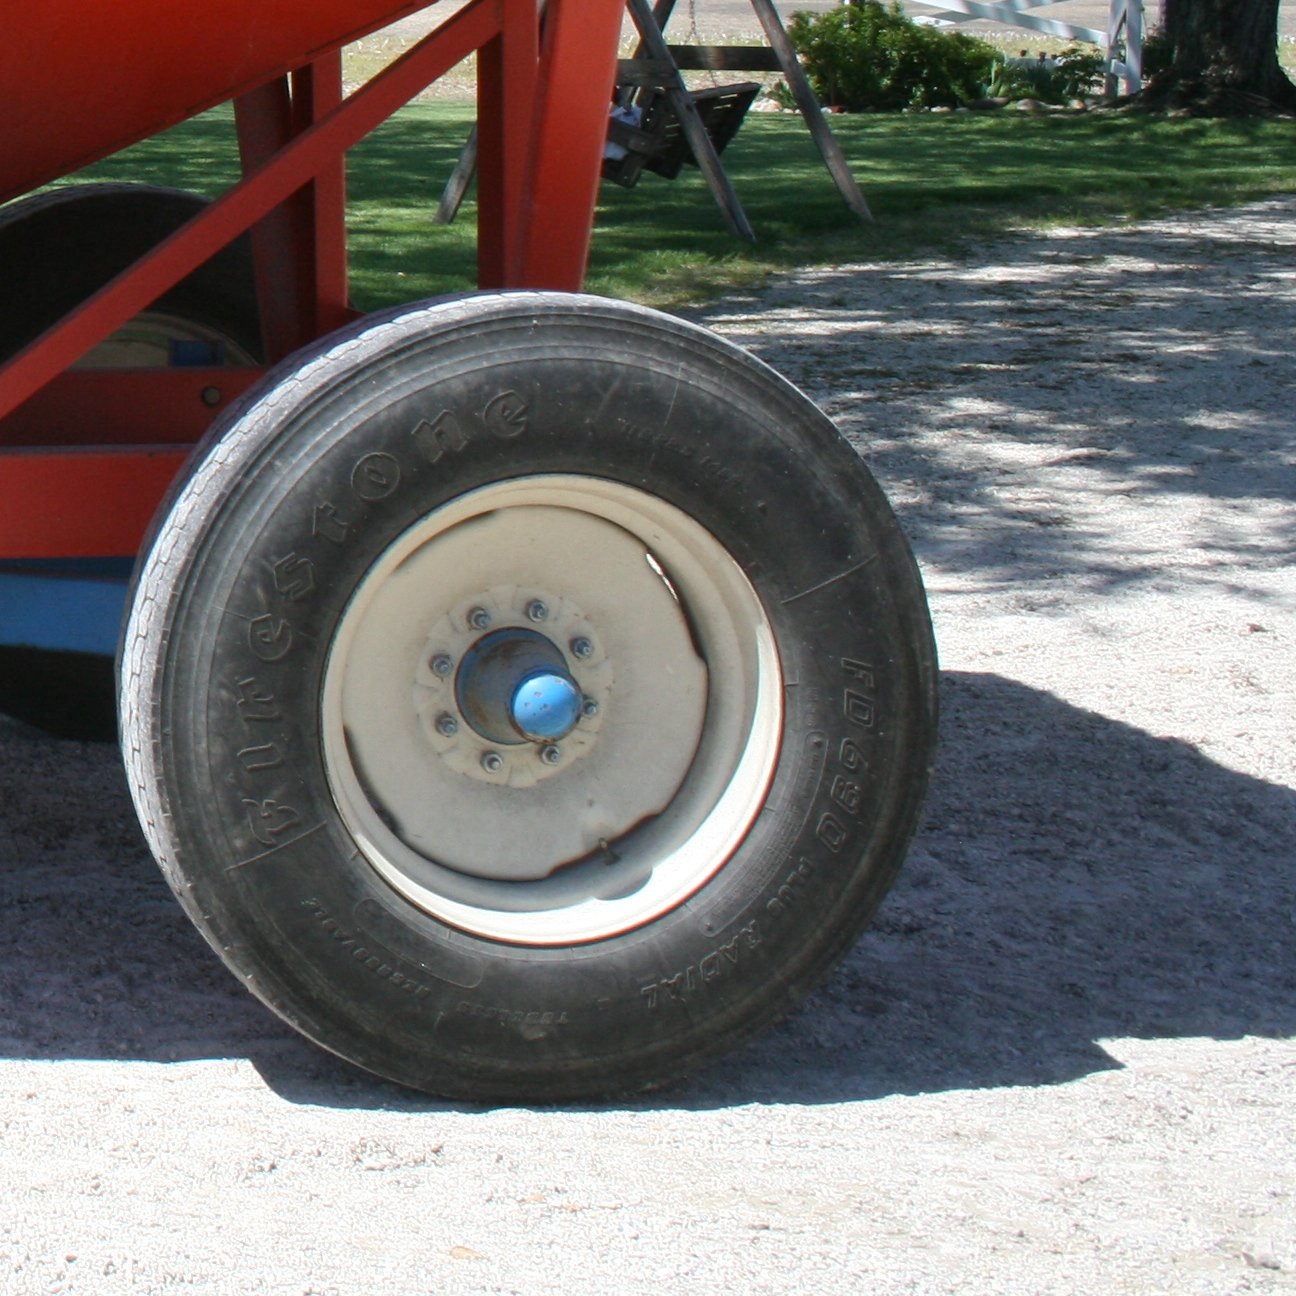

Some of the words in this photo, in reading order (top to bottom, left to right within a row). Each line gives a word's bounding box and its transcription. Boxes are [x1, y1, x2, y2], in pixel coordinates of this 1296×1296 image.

[237, 390, 528, 846] Firestone
[840, 658, 875, 728] FD
[641, 919, 761, 1009] RADIAL
